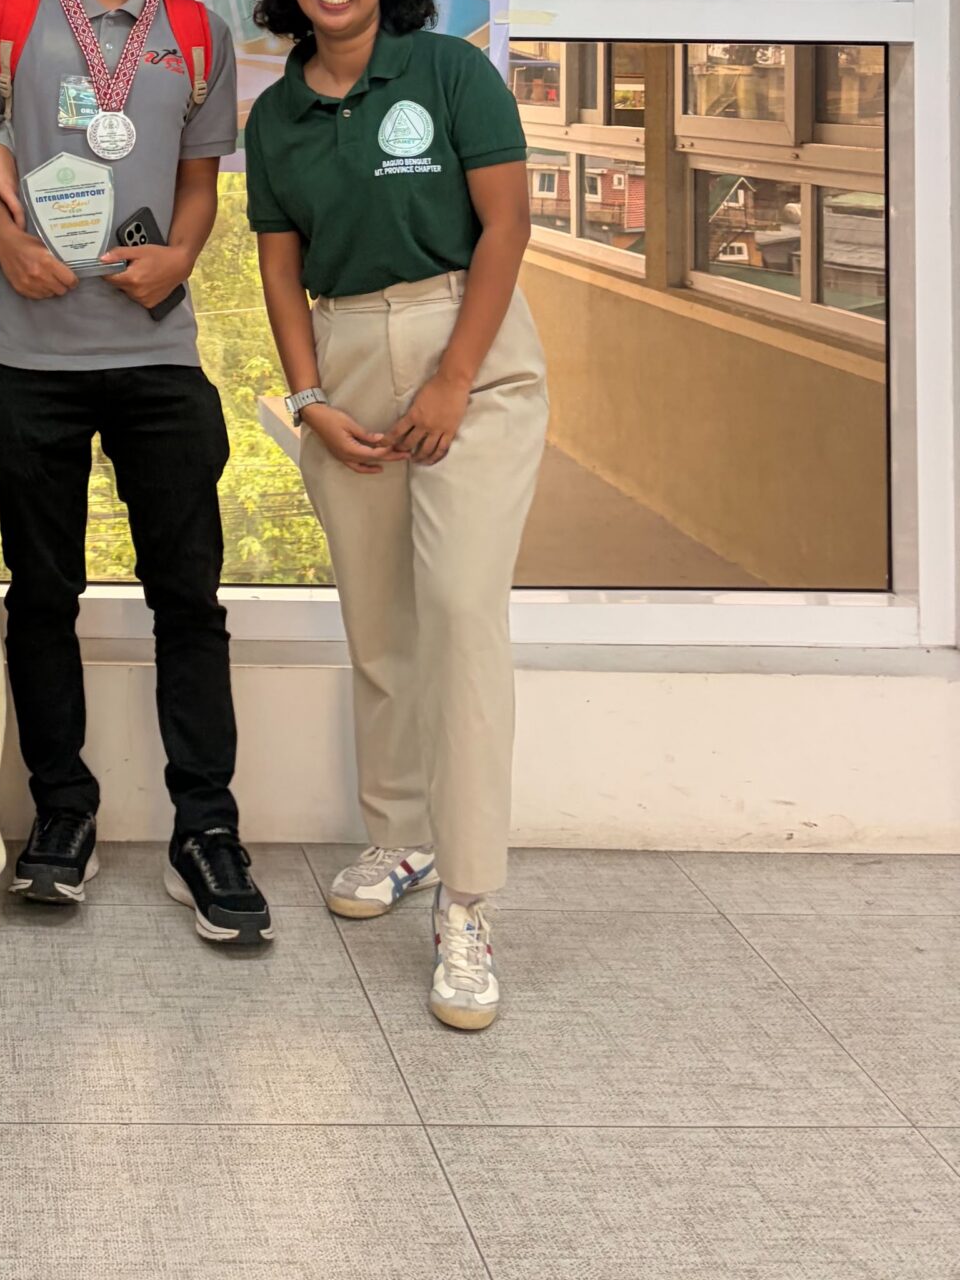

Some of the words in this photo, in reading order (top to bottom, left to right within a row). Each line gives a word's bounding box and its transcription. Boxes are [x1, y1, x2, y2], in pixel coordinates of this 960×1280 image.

[384, 165, 414, 175] PROVINCE
[414, 164, 442, 173] CHAPTER
[35, 188, 106, 203] INTERLABORATORY
